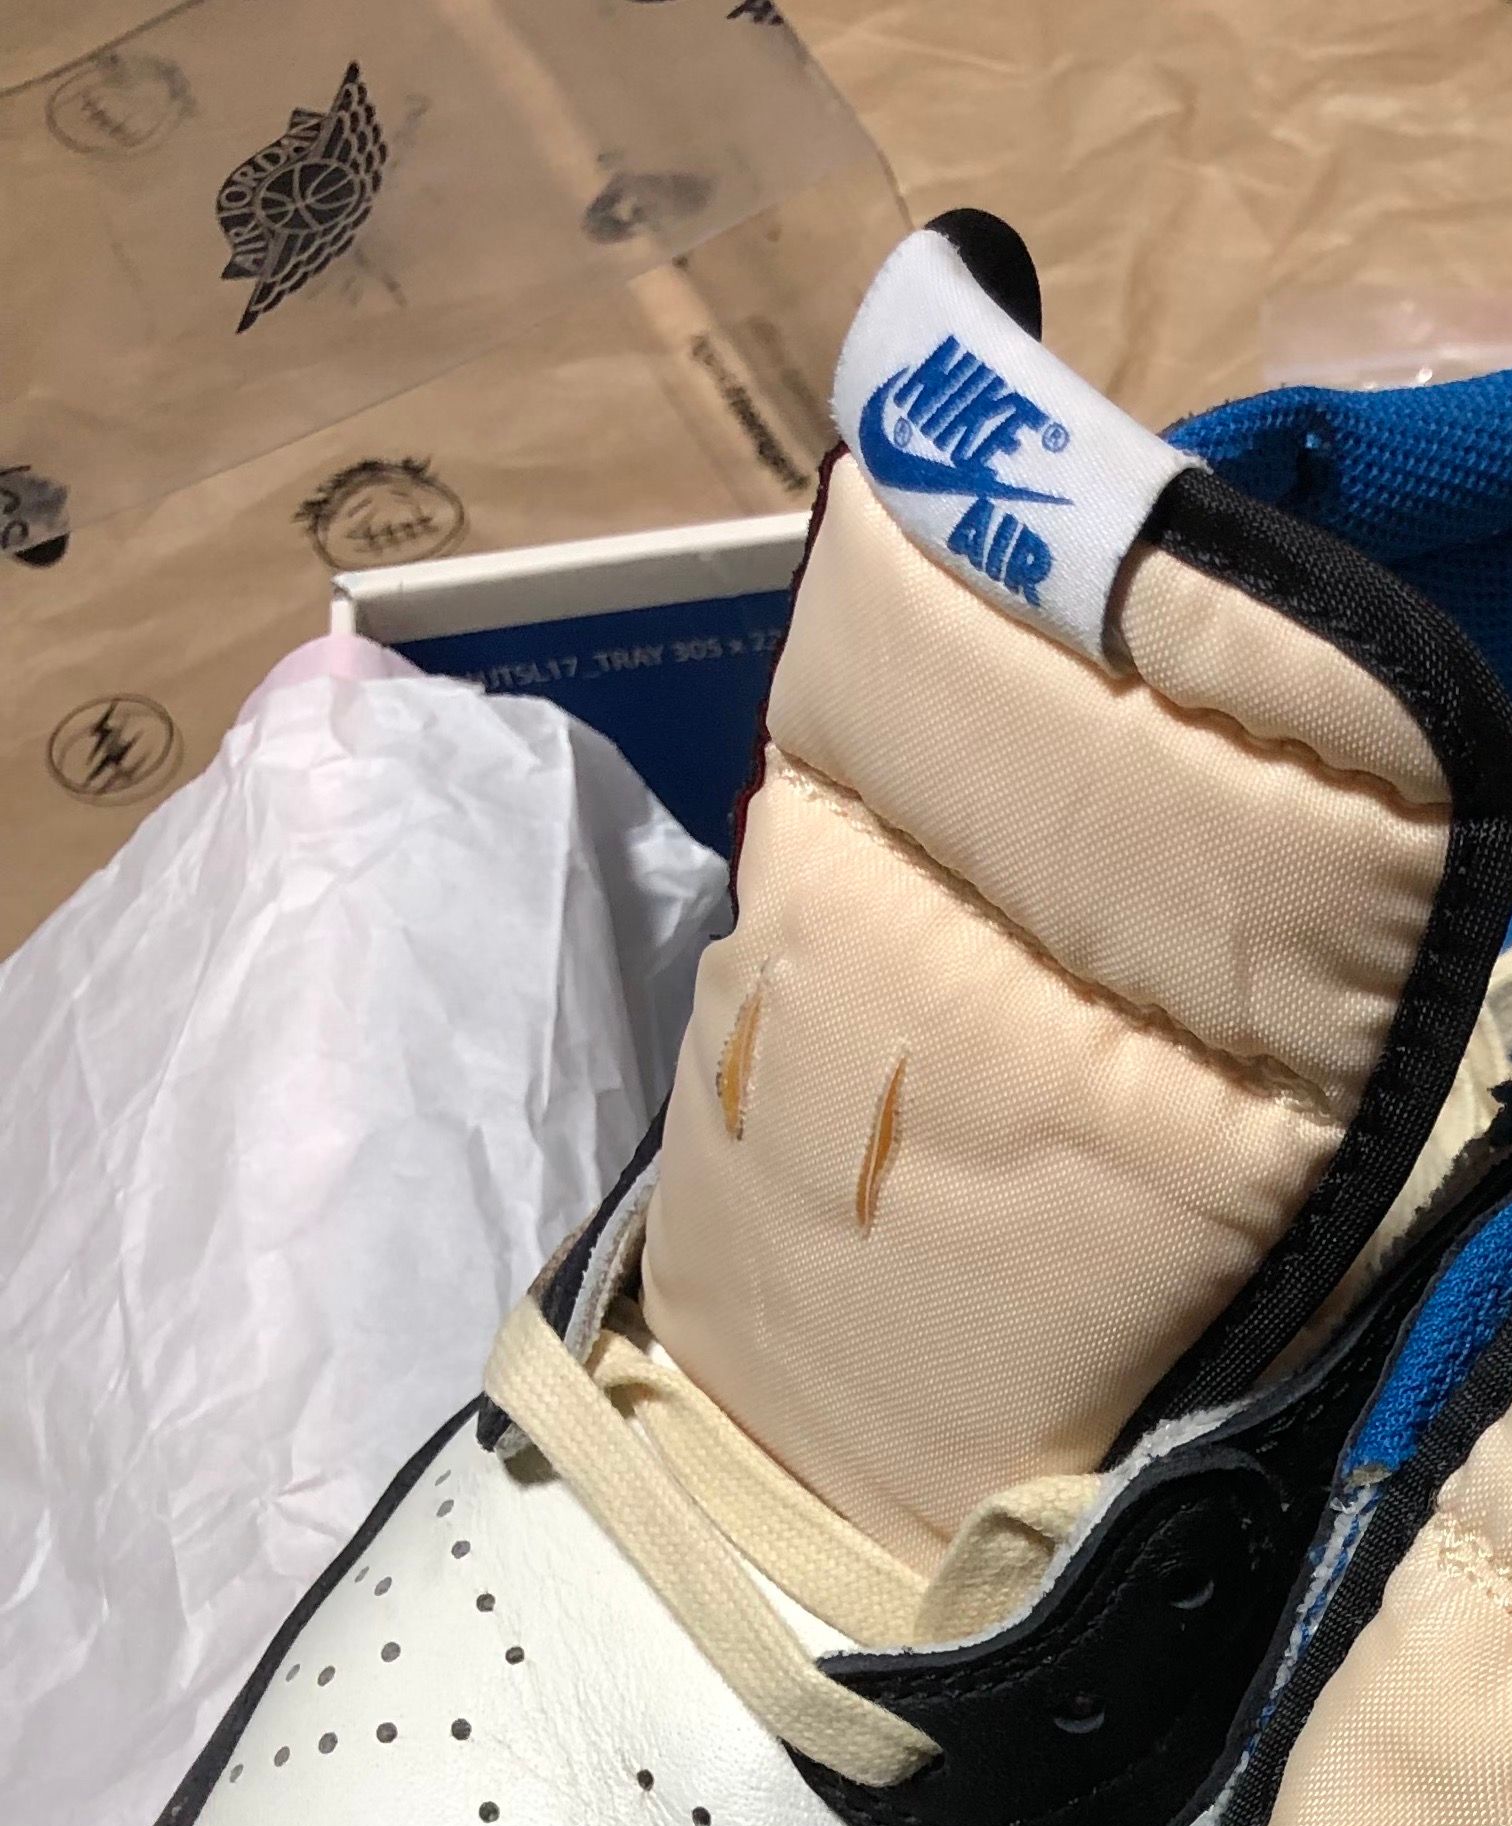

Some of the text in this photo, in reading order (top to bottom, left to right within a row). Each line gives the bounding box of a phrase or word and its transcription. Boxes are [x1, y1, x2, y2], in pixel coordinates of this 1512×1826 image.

[217, 112, 322, 272] AIR JORDAN
[893, 333, 1050, 484] NIKE
[947, 497, 1054, 608] AIR
